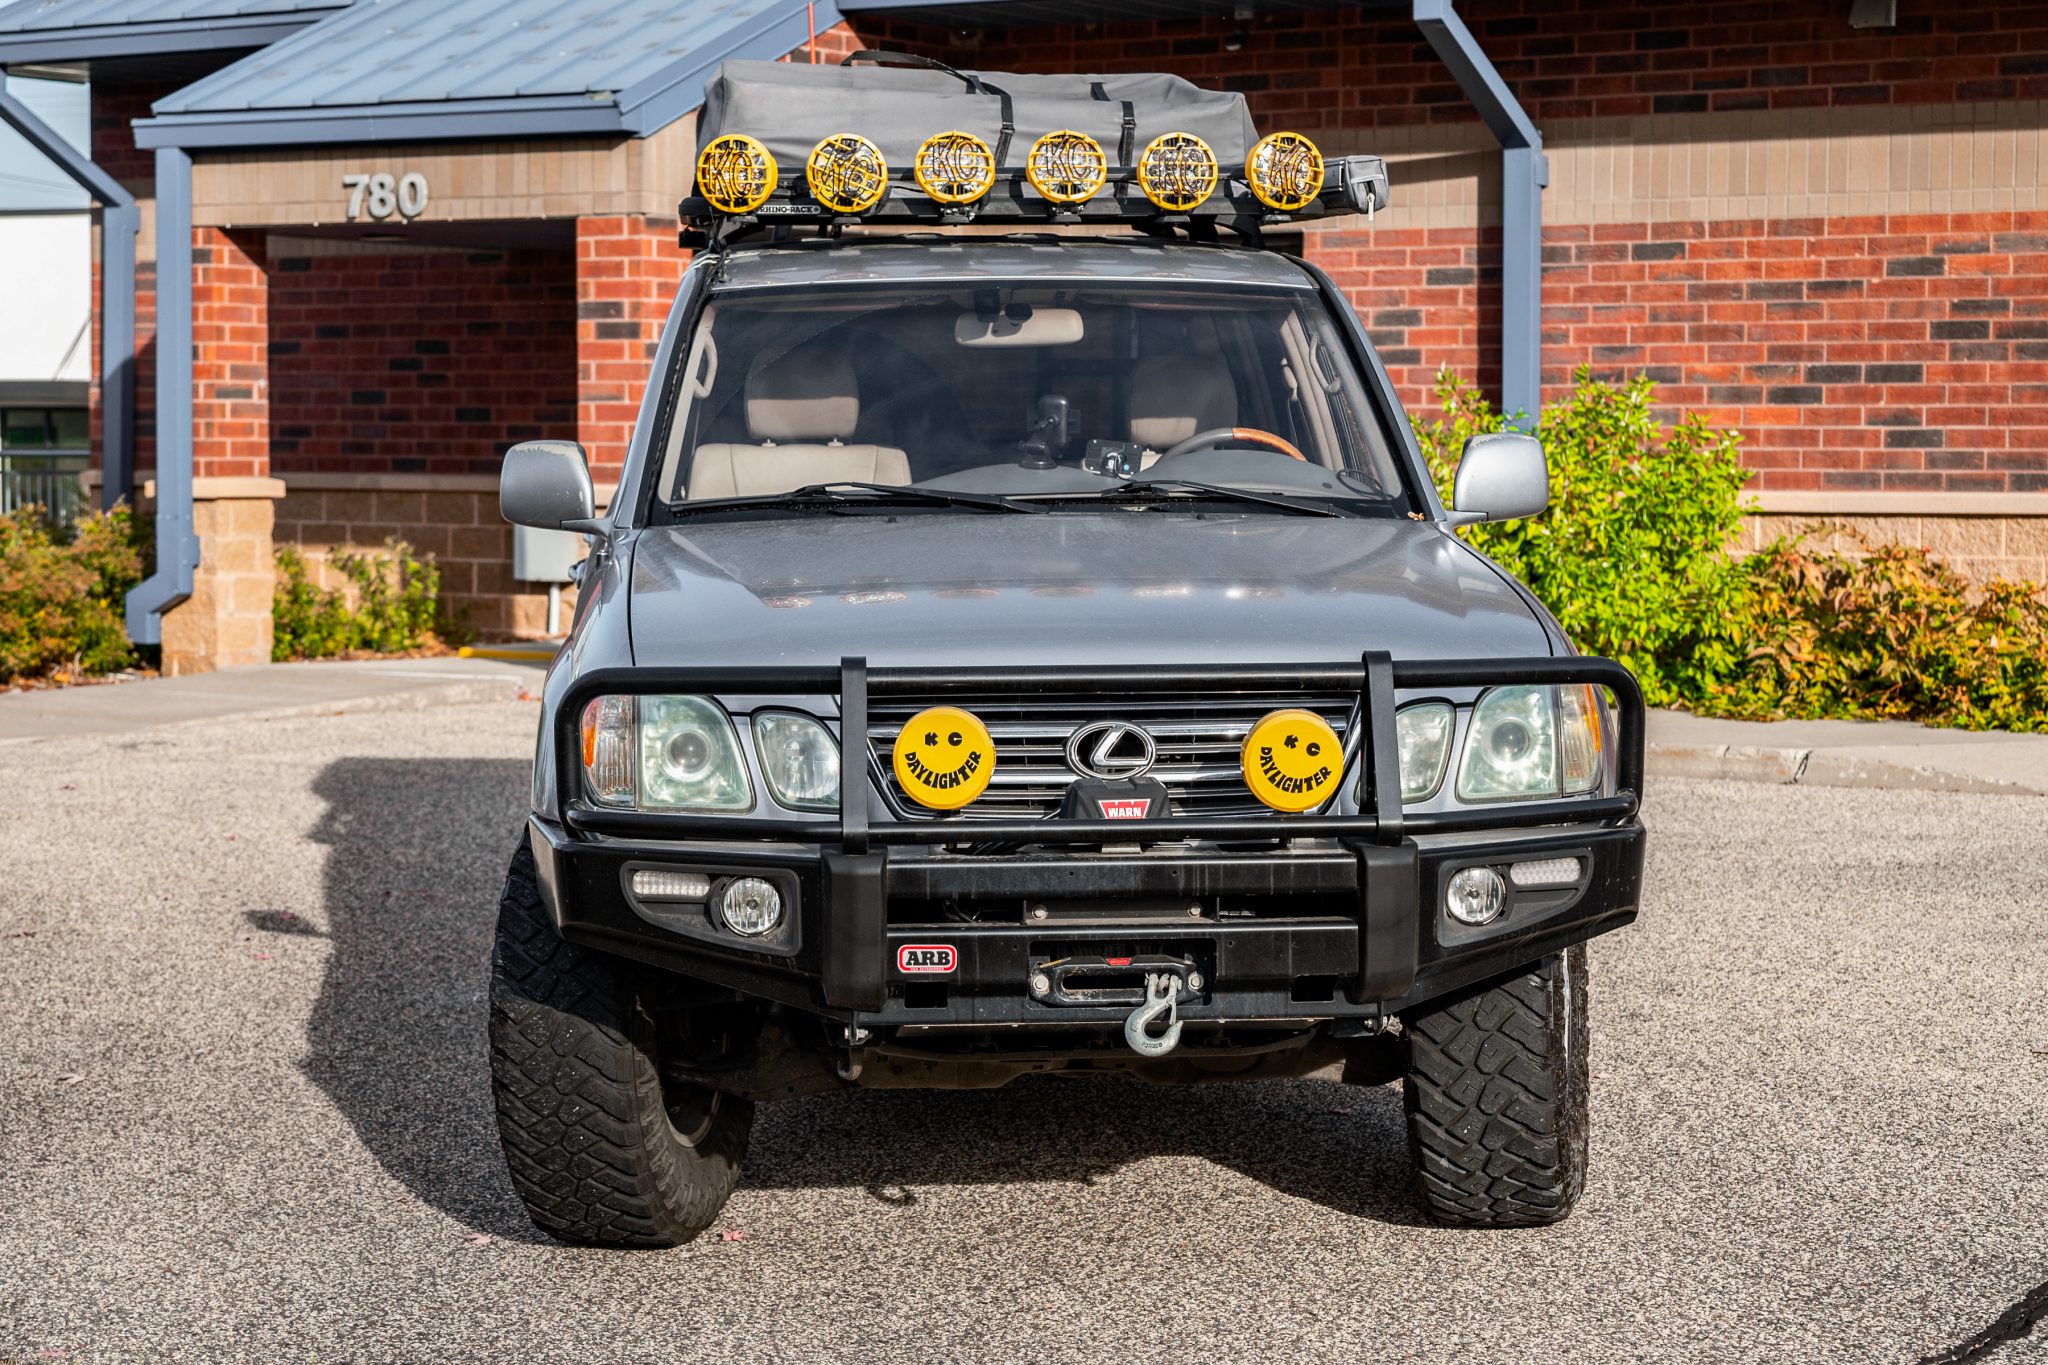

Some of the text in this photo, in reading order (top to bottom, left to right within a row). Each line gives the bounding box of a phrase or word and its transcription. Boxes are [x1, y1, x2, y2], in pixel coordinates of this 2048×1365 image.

[932, 134, 979, 183] KC
[1045, 135, 1091, 183] KC
[342, 171, 428, 219] 780
[904, 750, 982, 789] DAYLIGHTER
[1259, 746, 1333, 794] DAYLIGHTER
[1107, 807, 1142, 818] WARN
[905, 951, 951, 966] ARB
